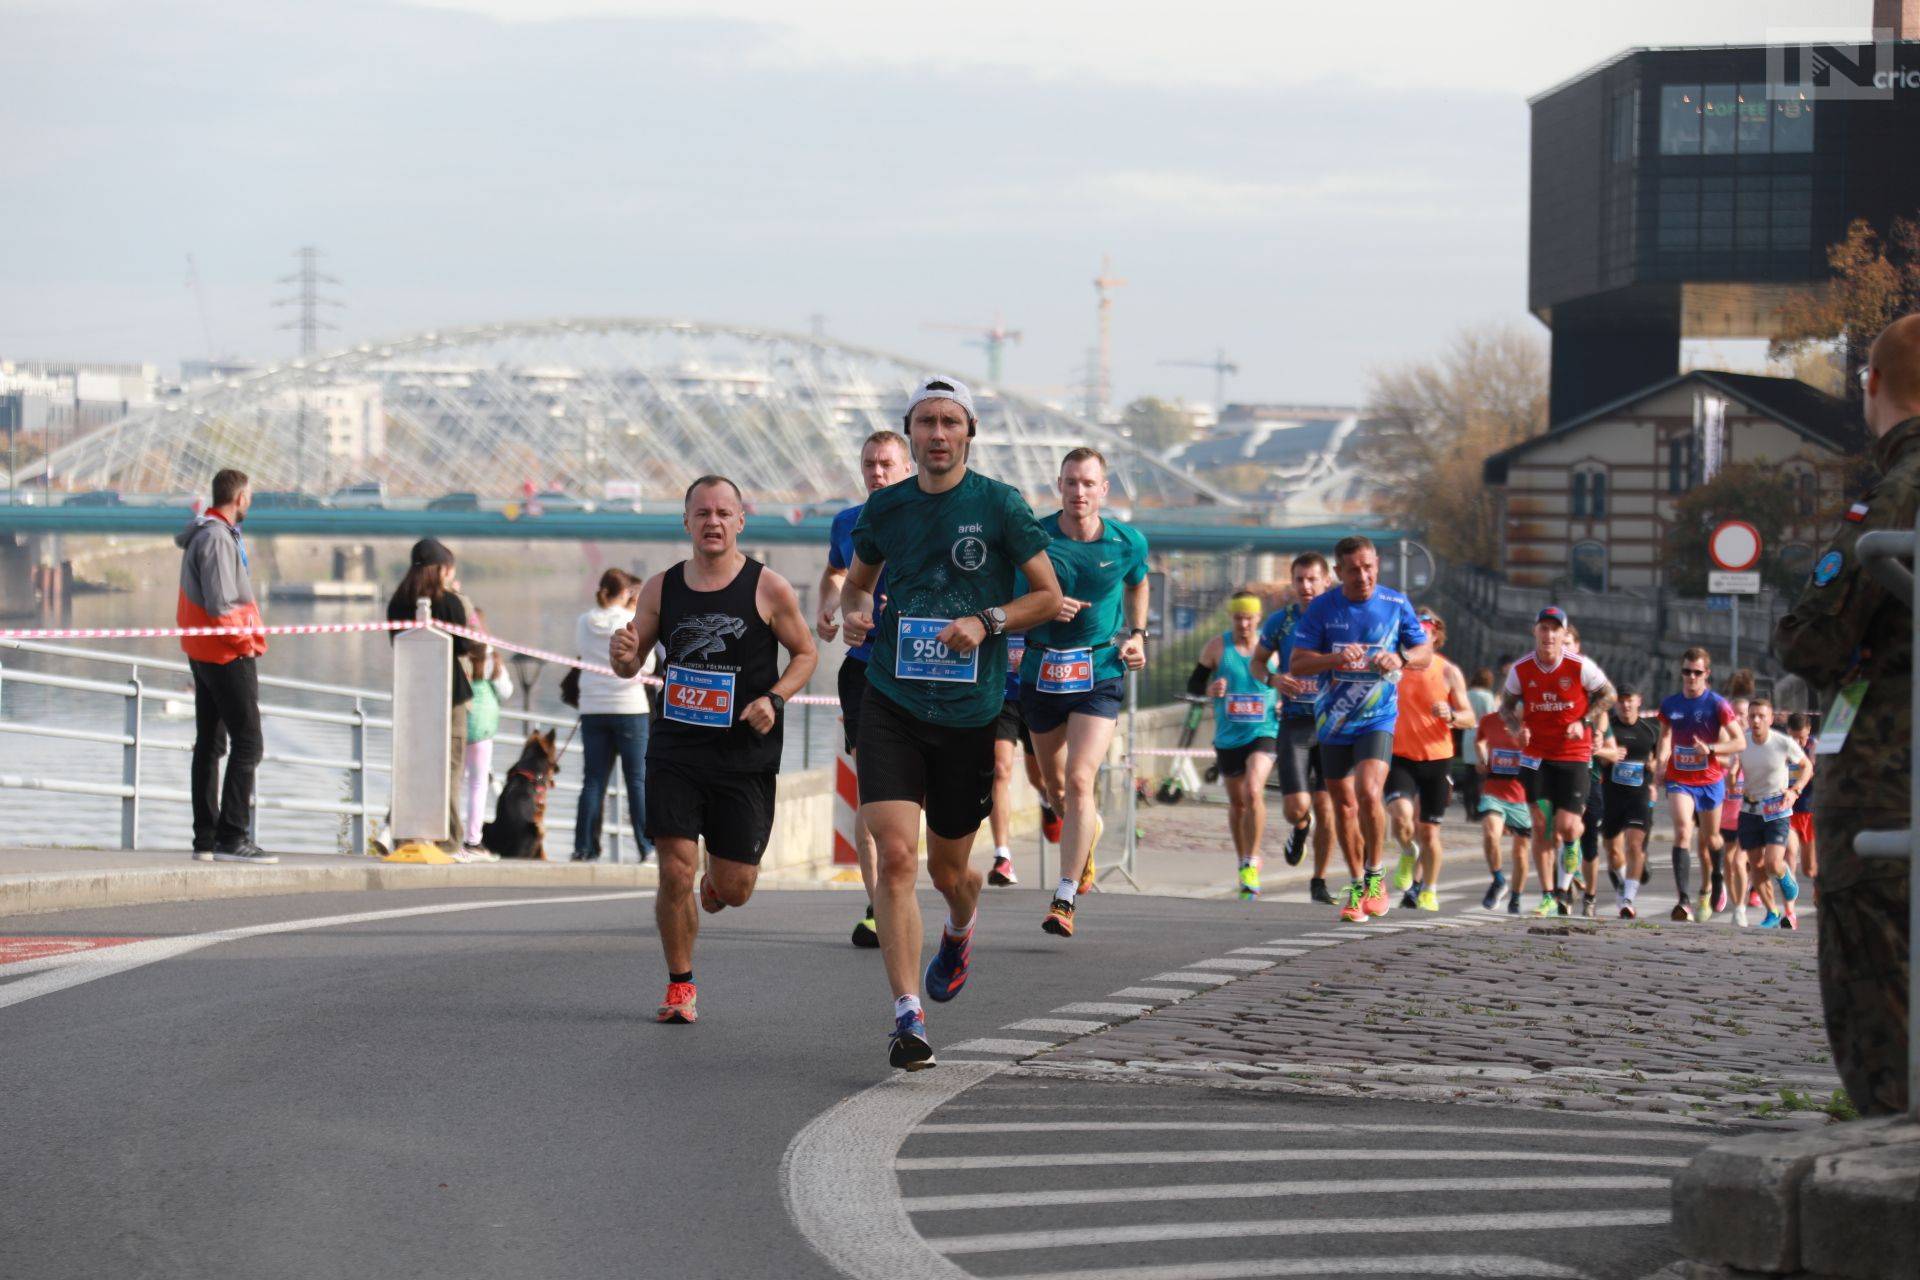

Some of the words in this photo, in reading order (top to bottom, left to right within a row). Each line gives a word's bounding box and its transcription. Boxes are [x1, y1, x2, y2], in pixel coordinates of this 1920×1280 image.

[958, 523, 983, 533] arek
[913, 640, 948, 659] 950
[1046, 664, 1073, 679] 489
[676, 687, 707, 706] 427
[1542, 692, 1557, 702] Fly
[1530, 702, 1575, 712] Emirates
